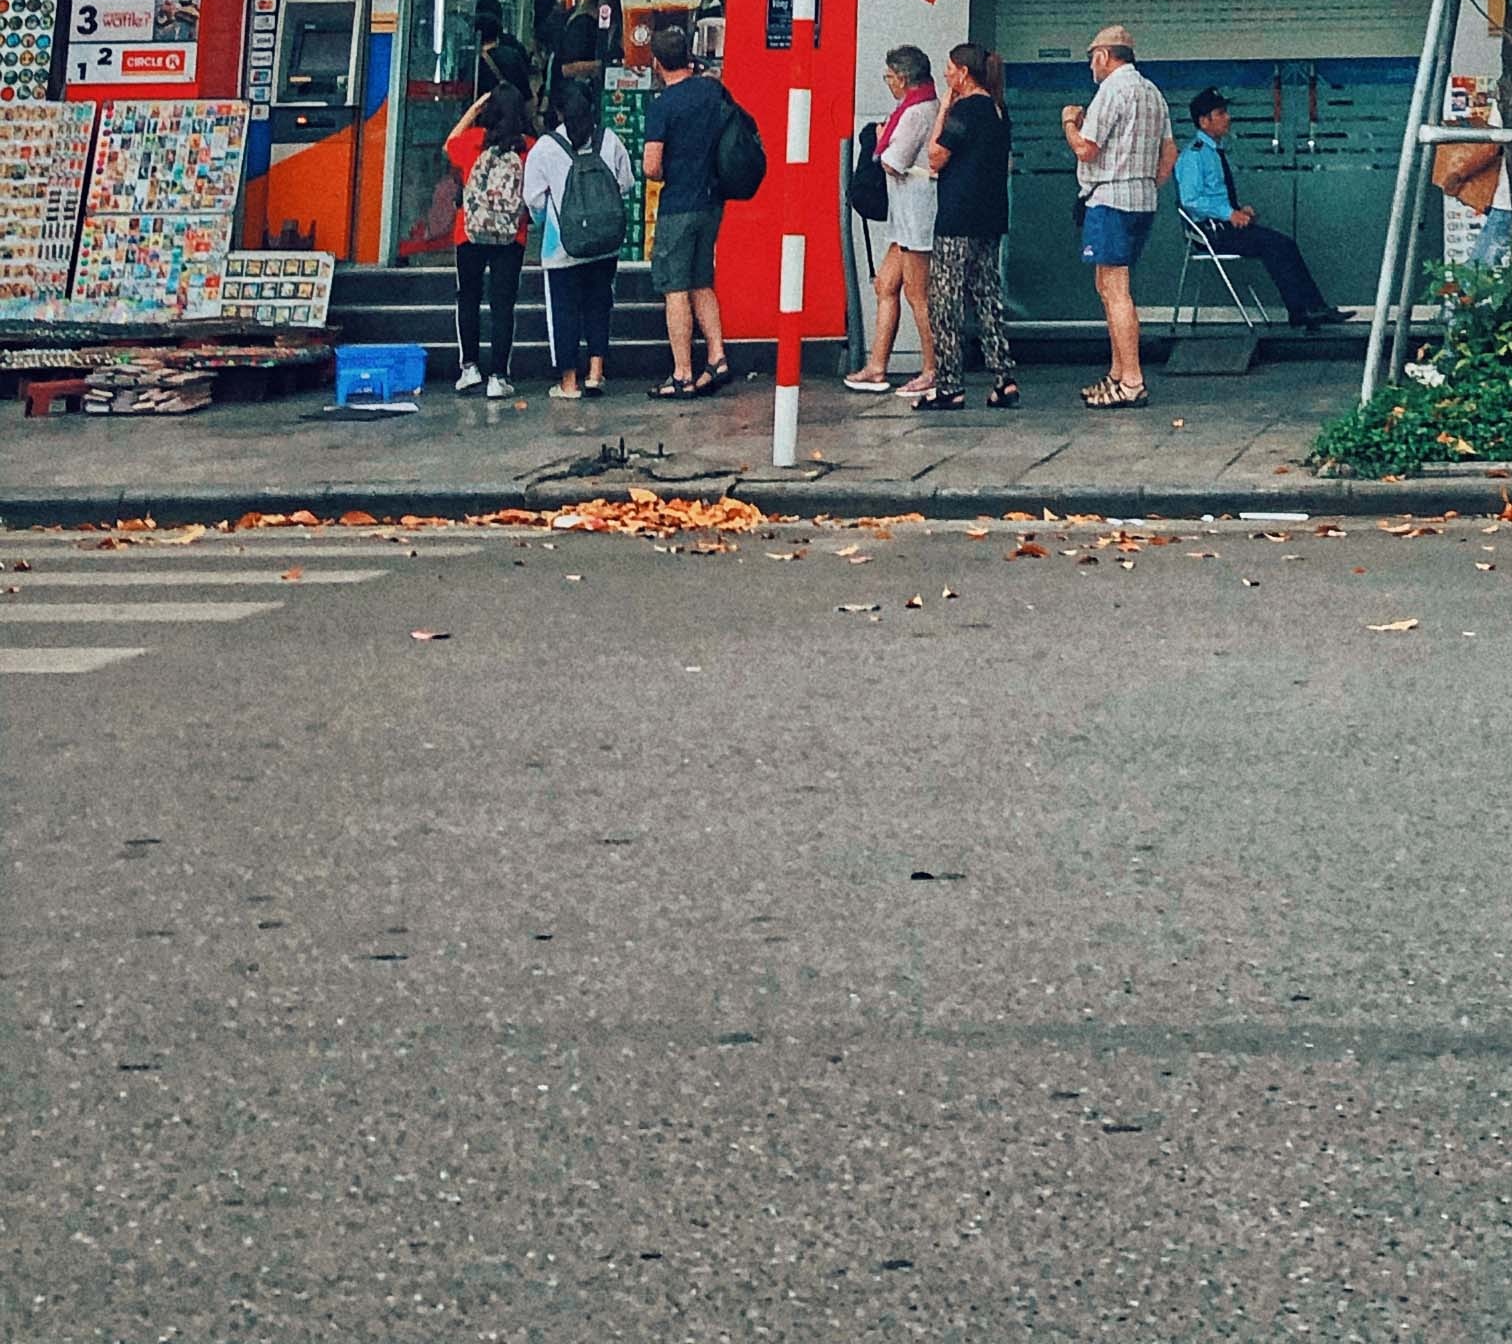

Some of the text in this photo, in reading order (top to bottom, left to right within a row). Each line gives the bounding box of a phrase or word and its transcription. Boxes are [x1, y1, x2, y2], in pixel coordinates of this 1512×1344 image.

[76, 4, 98, 35] 3
[97, 47, 113, 66] 2
[126, 58, 164, 69] CIRCLE
[77, 62, 88, 81] 1
